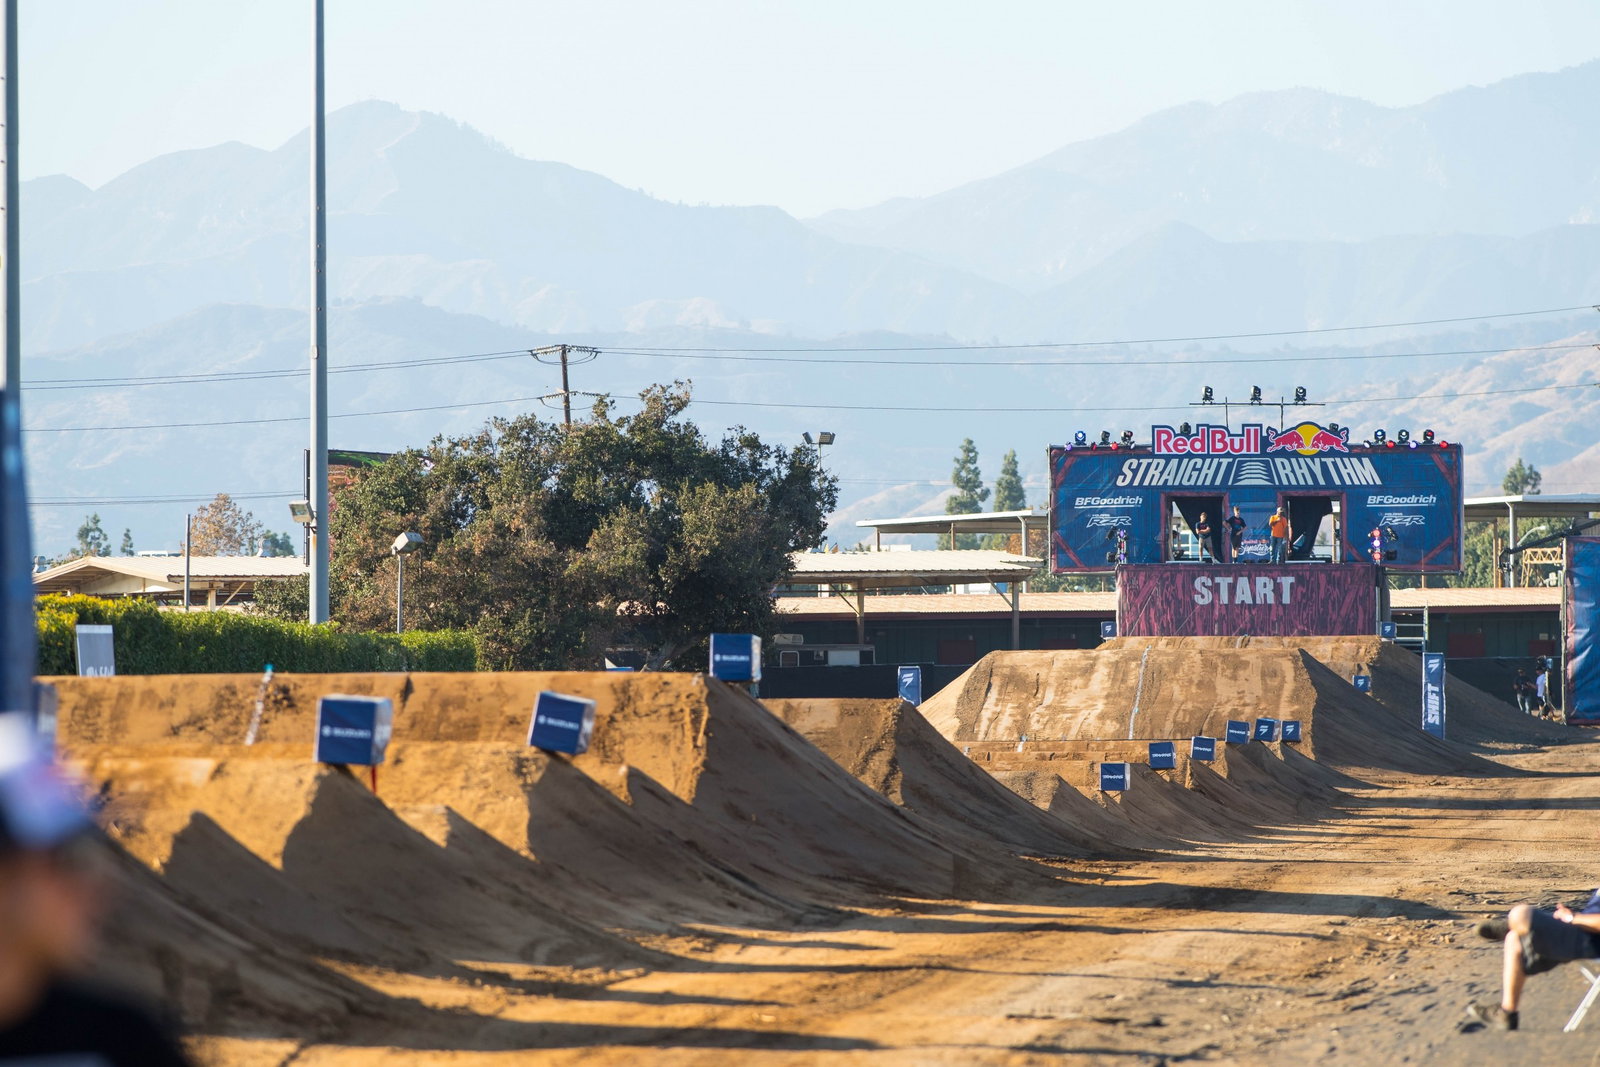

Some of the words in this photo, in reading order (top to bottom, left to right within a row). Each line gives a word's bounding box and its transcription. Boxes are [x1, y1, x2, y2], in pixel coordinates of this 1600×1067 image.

[1155, 427, 1206, 453] Red
[1210, 427, 1260, 453] Bull
[1116, 458, 1233, 487] STRAIGHT
[1274, 457, 1383, 486] RHYTHM
[1074, 496, 1143, 506] BFGoodrich
[1367, 494, 1437, 504] BFGoodrich
[1086, 515, 1132, 528] RZR
[1378, 514, 1426, 527] RZR
[1194, 576, 1295, 605] START
[1427, 683, 1440, 725] SHIFT
